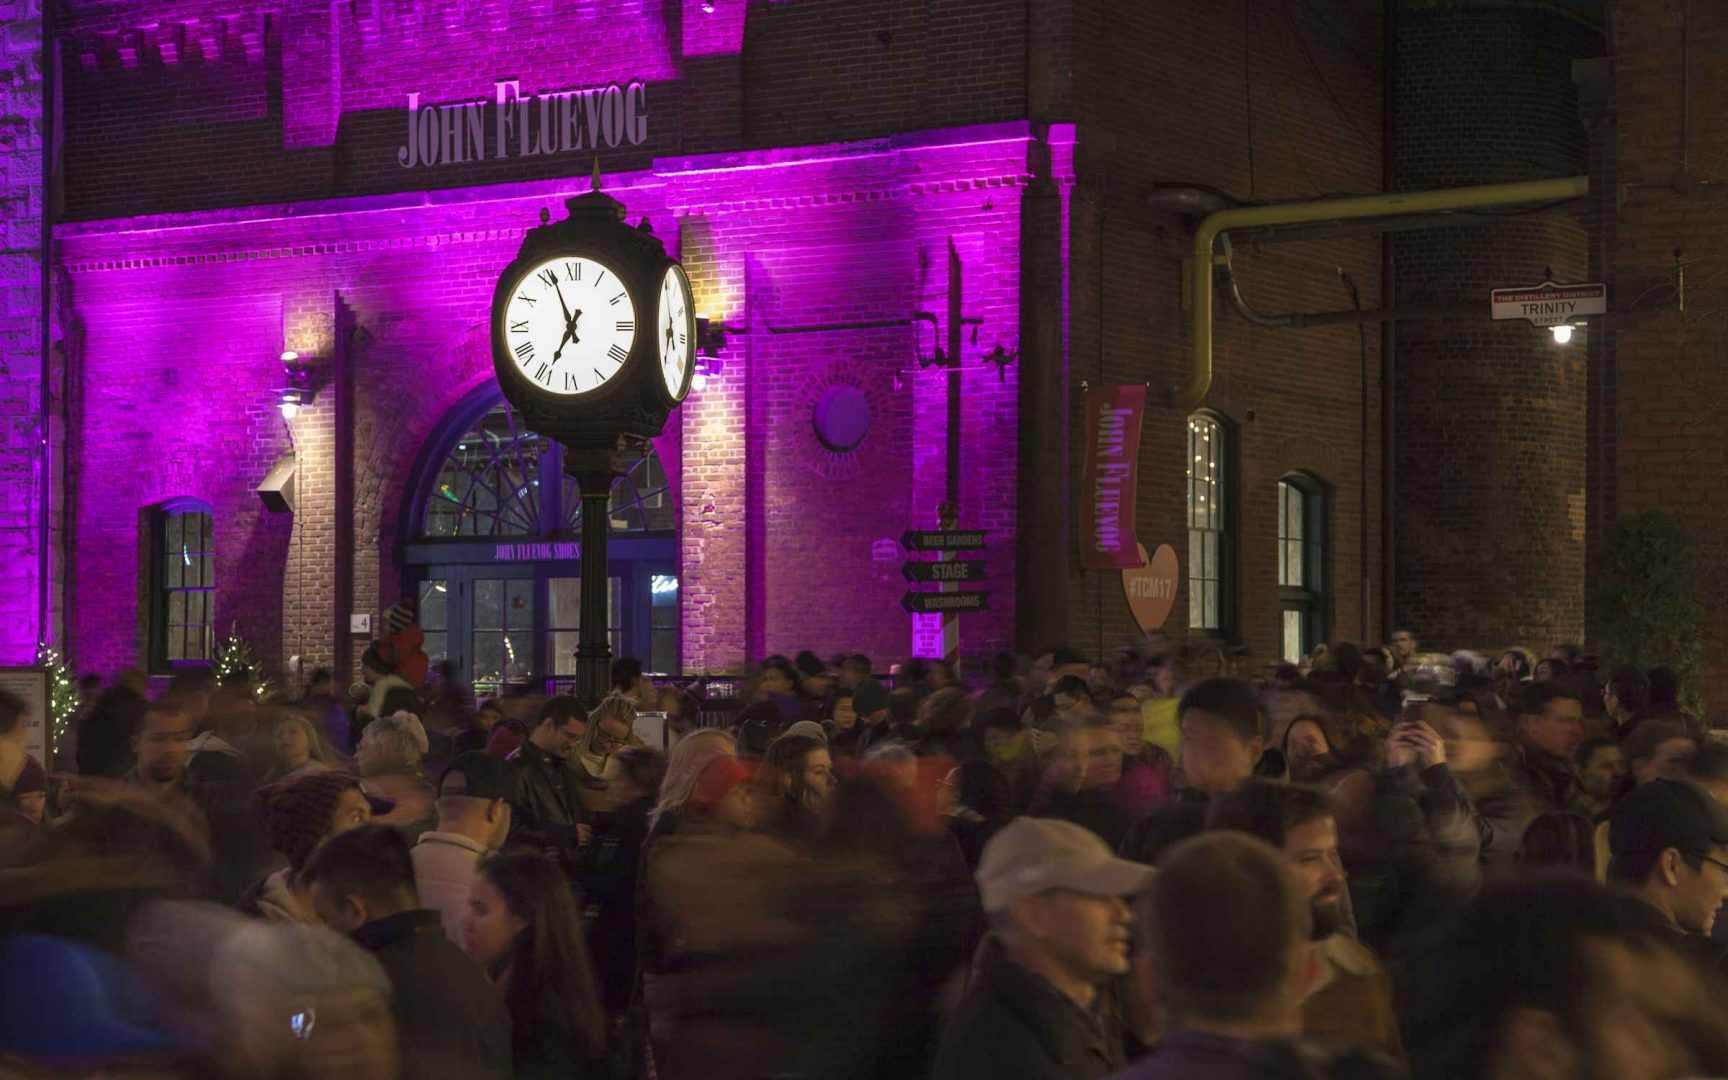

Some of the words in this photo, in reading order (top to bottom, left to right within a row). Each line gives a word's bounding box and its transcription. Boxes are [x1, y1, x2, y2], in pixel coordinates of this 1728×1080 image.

[398, 92, 488, 169] JOHN
[494, 79, 650, 159] FLUEVOG
[1515, 292, 1561, 301] DISTILLERY
[1562, 290, 1600, 299] DISTRICT
[1521, 301, 1577, 315] TRINITY
[1534, 316, 1564, 324] STREET
[1096, 402, 1133, 457] JOHN
[1094, 463, 1130, 553] FLUEVOG
[923, 535, 945, 547] BEER
[946, 534, 983, 546] GARDENS
[494, 544, 514, 560] JOHN
[553, 542, 580, 559] SHOES
[932, 563, 968, 579] STAGE
[1129, 576, 1172, 599] #TCM17
[924, 595, 980, 609] WASHROOMS
[360, 616, 368, 630] 4
